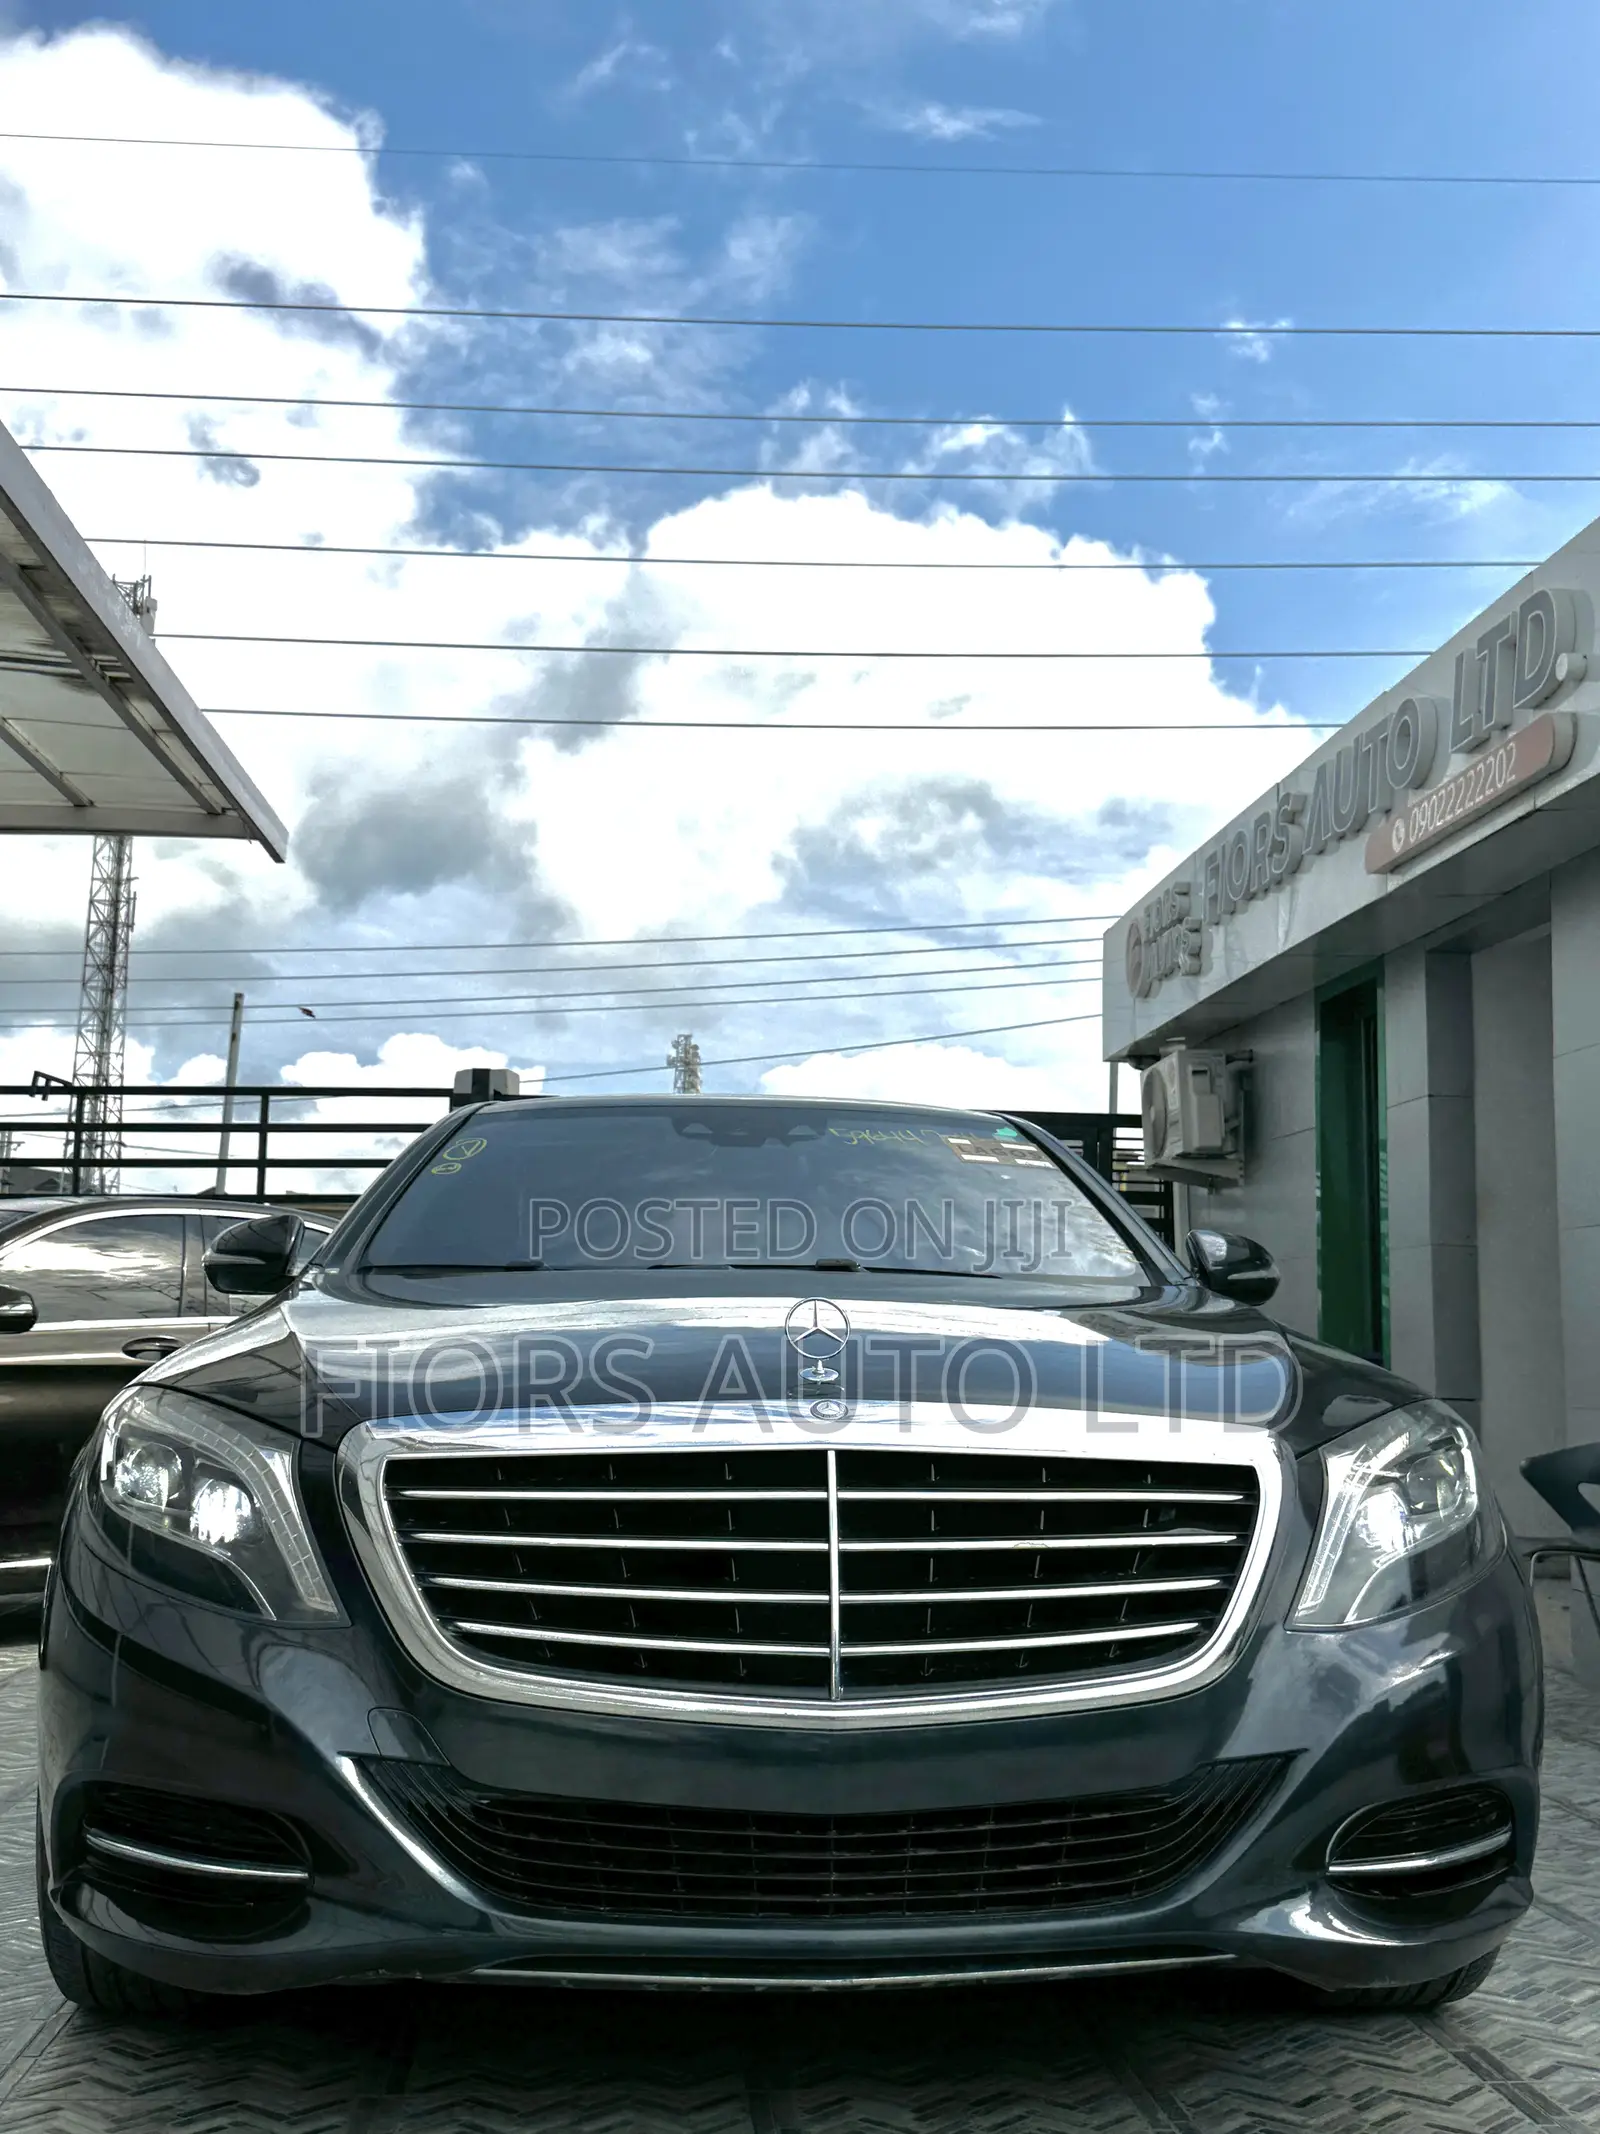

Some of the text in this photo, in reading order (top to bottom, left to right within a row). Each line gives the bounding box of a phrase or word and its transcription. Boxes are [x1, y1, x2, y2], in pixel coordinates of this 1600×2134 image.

[1202, 793, 1301, 925] FIORS
[1302, 697, 1432, 856] AUTO
[1408, 741, 1517, 844] 09022222202
